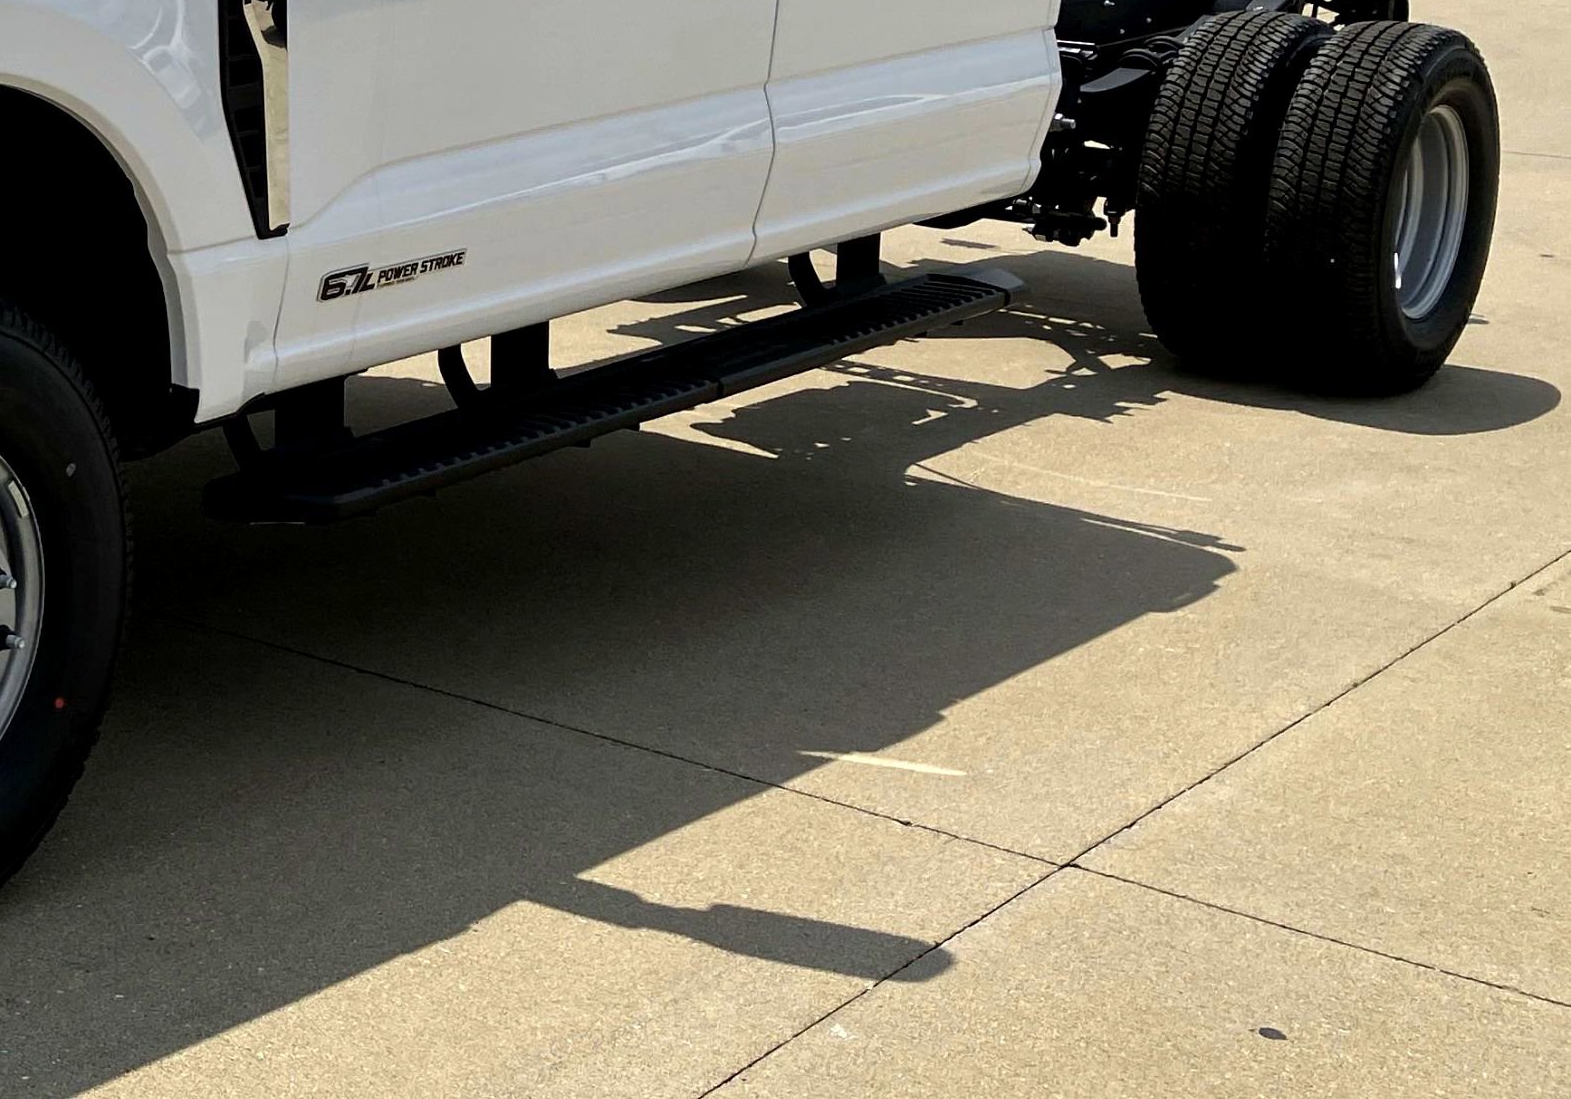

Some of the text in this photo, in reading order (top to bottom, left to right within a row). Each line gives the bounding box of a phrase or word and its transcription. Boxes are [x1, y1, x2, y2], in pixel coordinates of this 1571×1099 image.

[320, 266, 375, 301] 6.7L
[377, 262, 419, 283] POWER
[420, 252, 465, 273] STROKE
